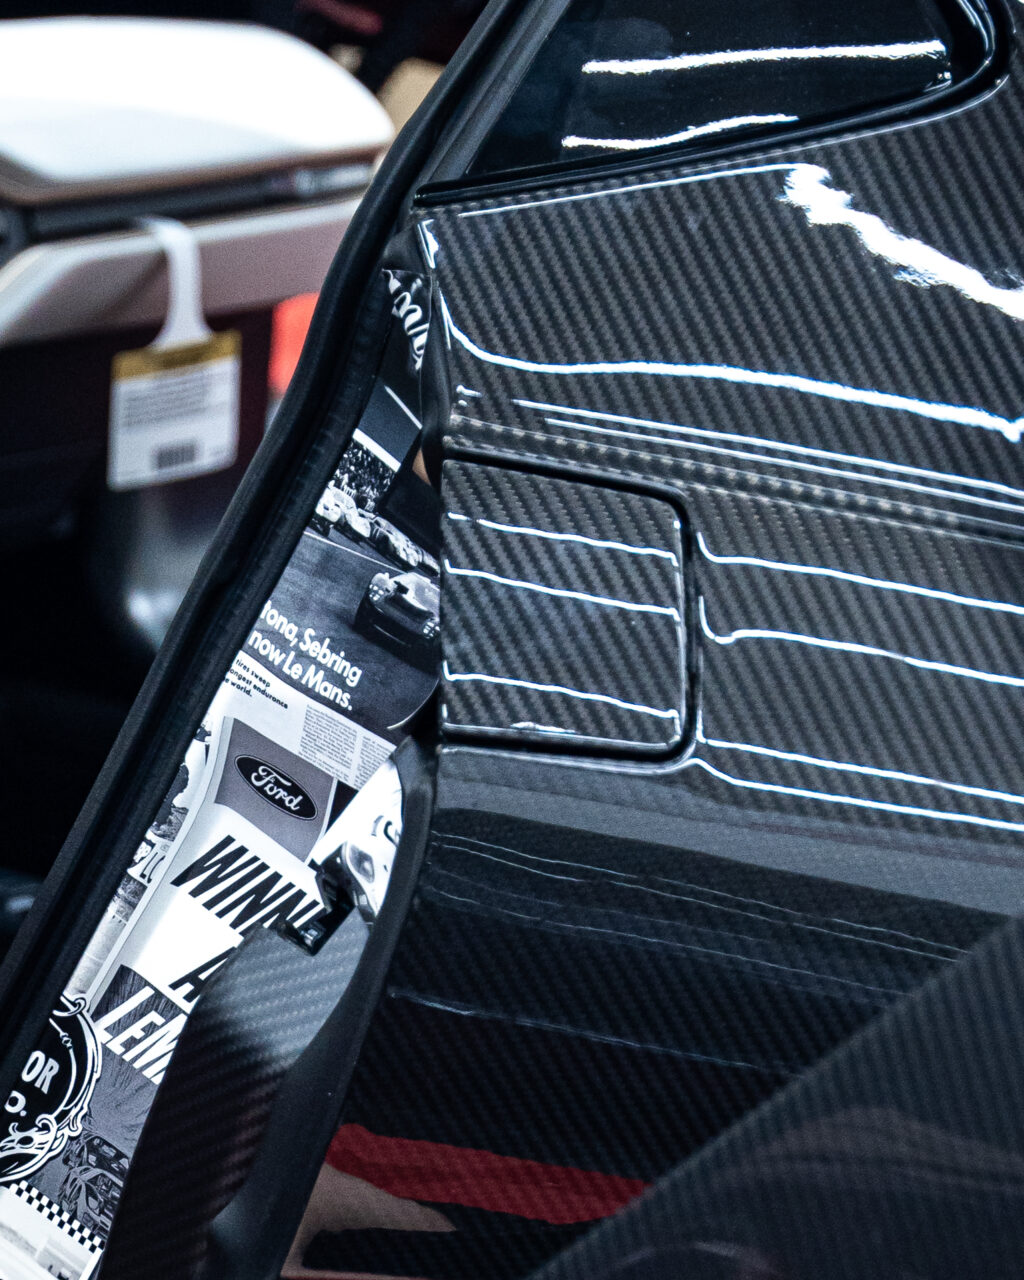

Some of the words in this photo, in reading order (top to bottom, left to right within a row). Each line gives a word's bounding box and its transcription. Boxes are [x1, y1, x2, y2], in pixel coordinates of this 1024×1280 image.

[235, 659, 250, 673] tires
[250, 670, 271, 688] sweep
[248, 630, 286, 666] now
[282, 651, 304, 680] Le
[301, 664, 353, 711] Mans.
[299, 628, 363, 687] Sebring
[231, 681, 253, 697] world.
[253, 684, 288, 709] endurance
[251, 765, 304, 811] Ford
[170, 834, 327, 936] WINN
